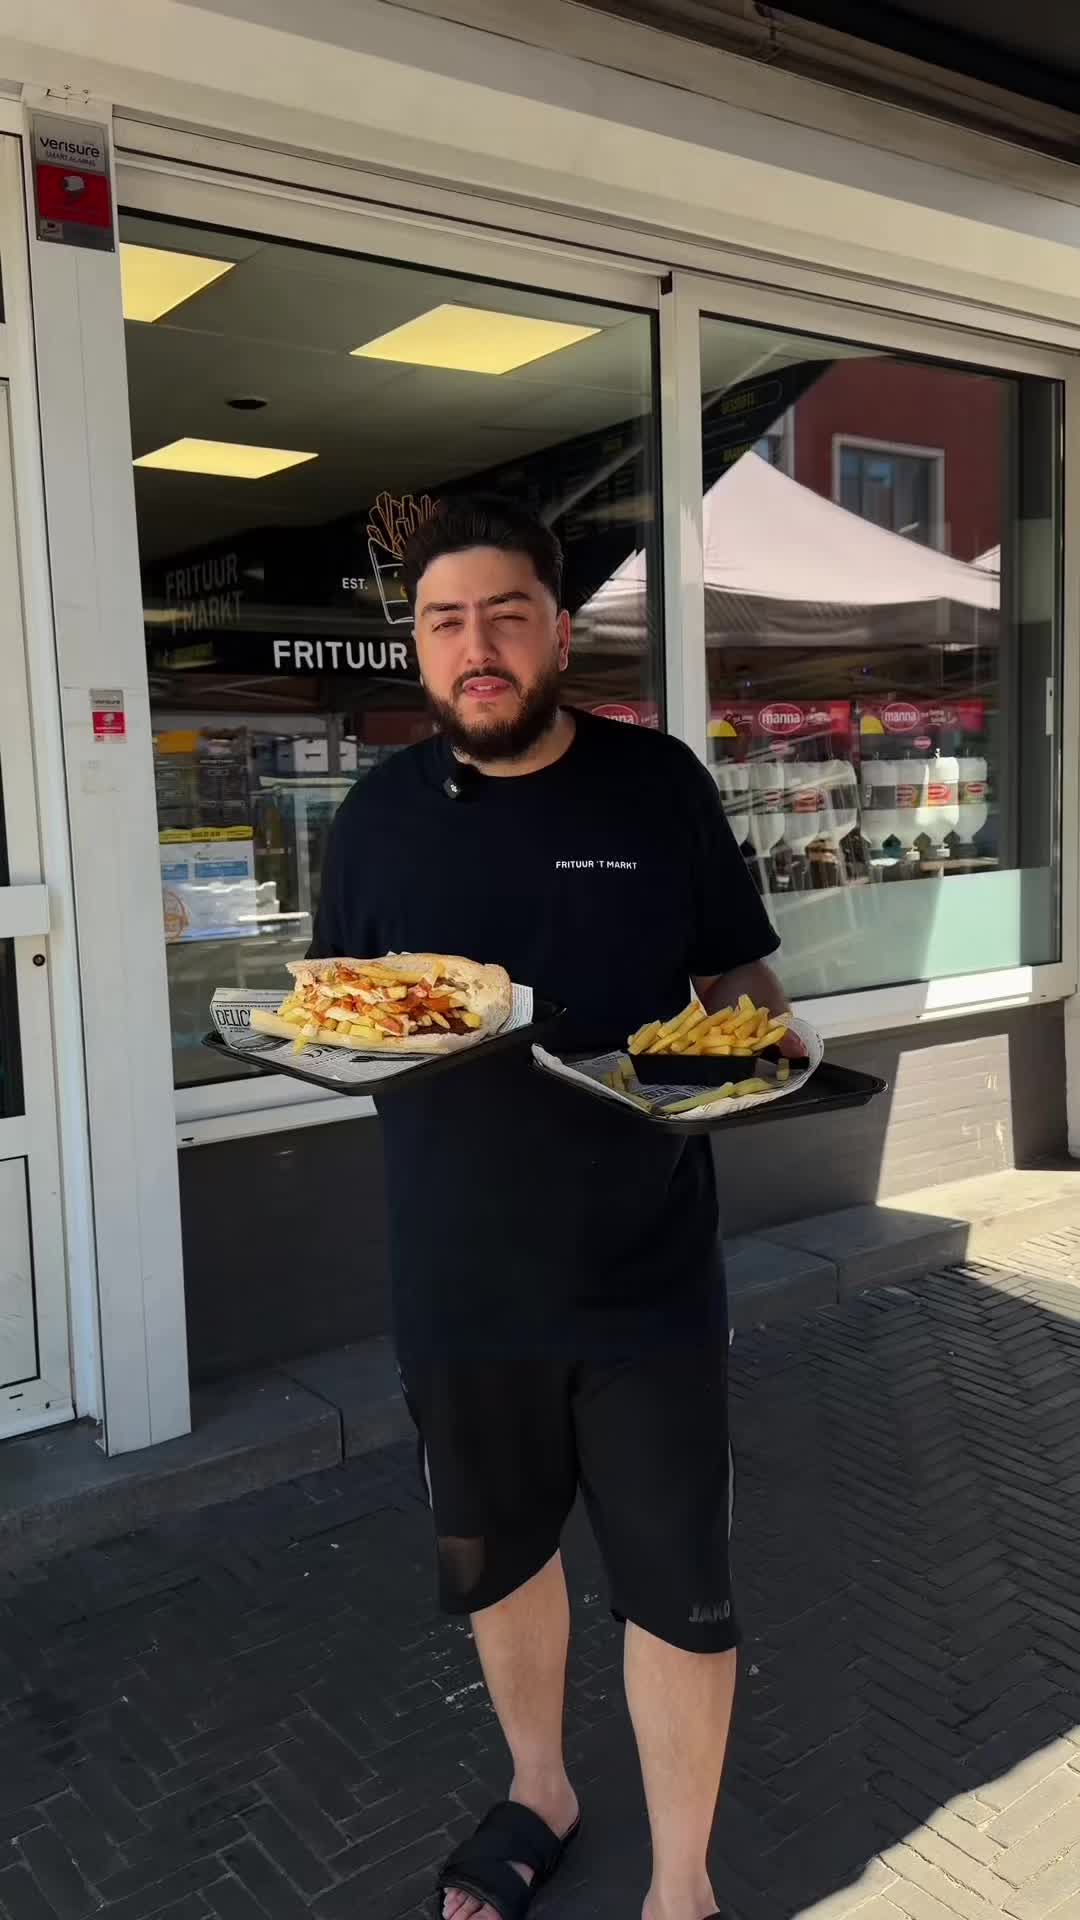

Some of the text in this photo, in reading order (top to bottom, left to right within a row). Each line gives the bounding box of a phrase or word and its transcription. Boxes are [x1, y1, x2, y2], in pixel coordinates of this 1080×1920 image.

[39, 137, 100, 158] verisure
[164, 552, 238, 606] FRITUUR
[342, 577, 368, 590] EST.
[273, 640, 408, 670] FRITUUR
[761, 712, 801, 725] manna
[884, 710, 917, 722] manna
[555, 860, 594, 869] FRITUUR
[606, 861, 637, 870] MARKT
[215, 1009, 251, 1027] DELIC
